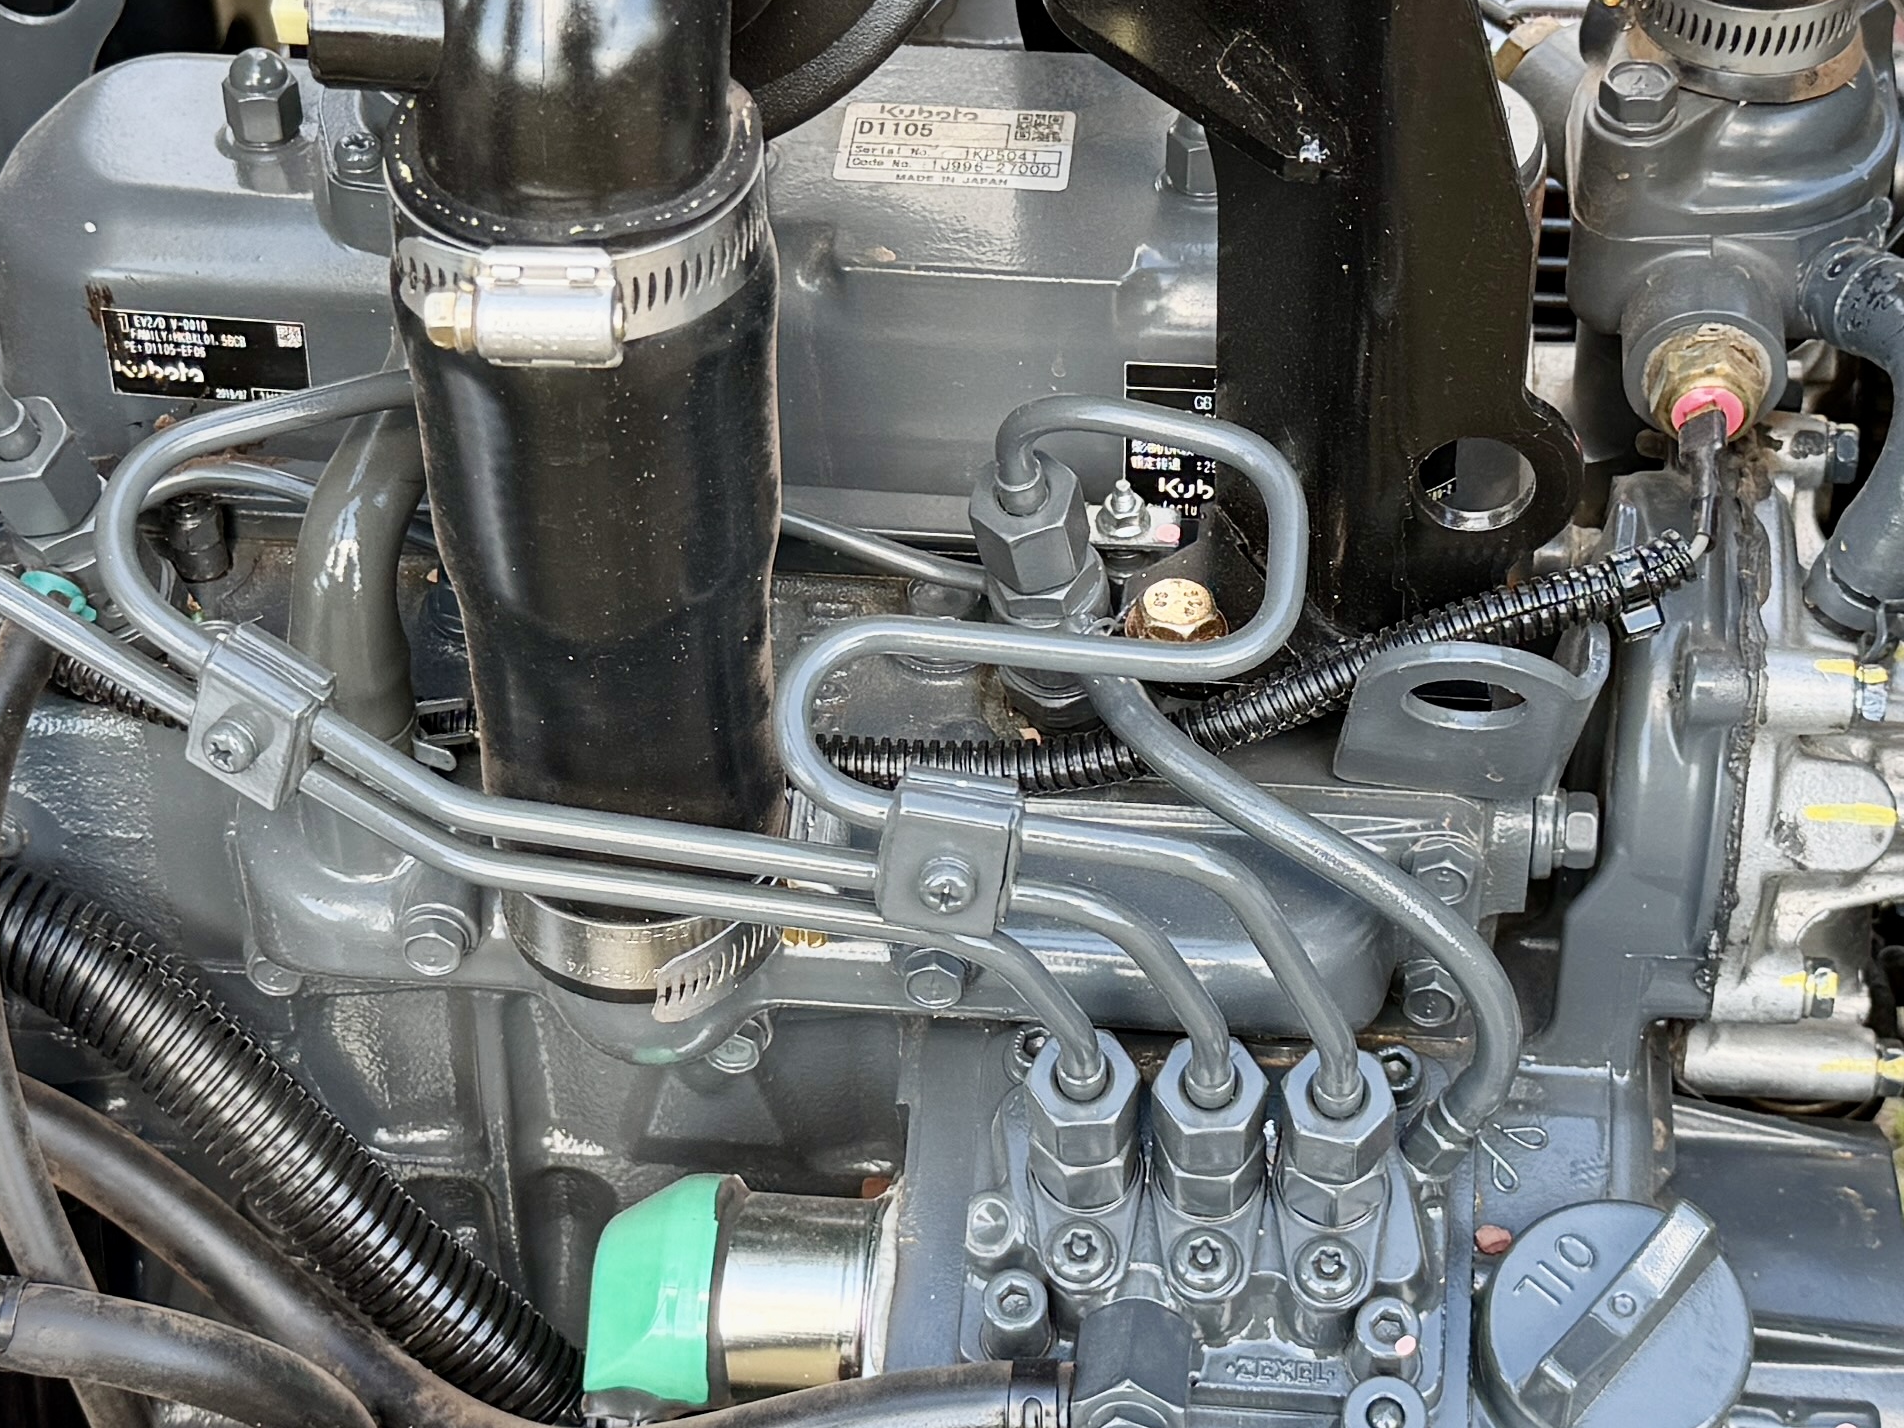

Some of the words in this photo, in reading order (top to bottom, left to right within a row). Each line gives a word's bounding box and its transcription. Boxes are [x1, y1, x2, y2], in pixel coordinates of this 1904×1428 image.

[878, 104, 979, 121] Kubota
[858, 120, 934, 137] D1105
[853, 145, 901, 155] Serial
[851, 157, 885, 167] Code
[895, 173, 933, 182] MADE
[961, 177, 1008, 186] JAPAN
[112, 357, 205, 383] Kubota
[1158, 477, 1214, 499] Kub
[1511, 1230, 1600, 1307] OIL
[1235, 1355, 1330, 1386] ZEXEL
